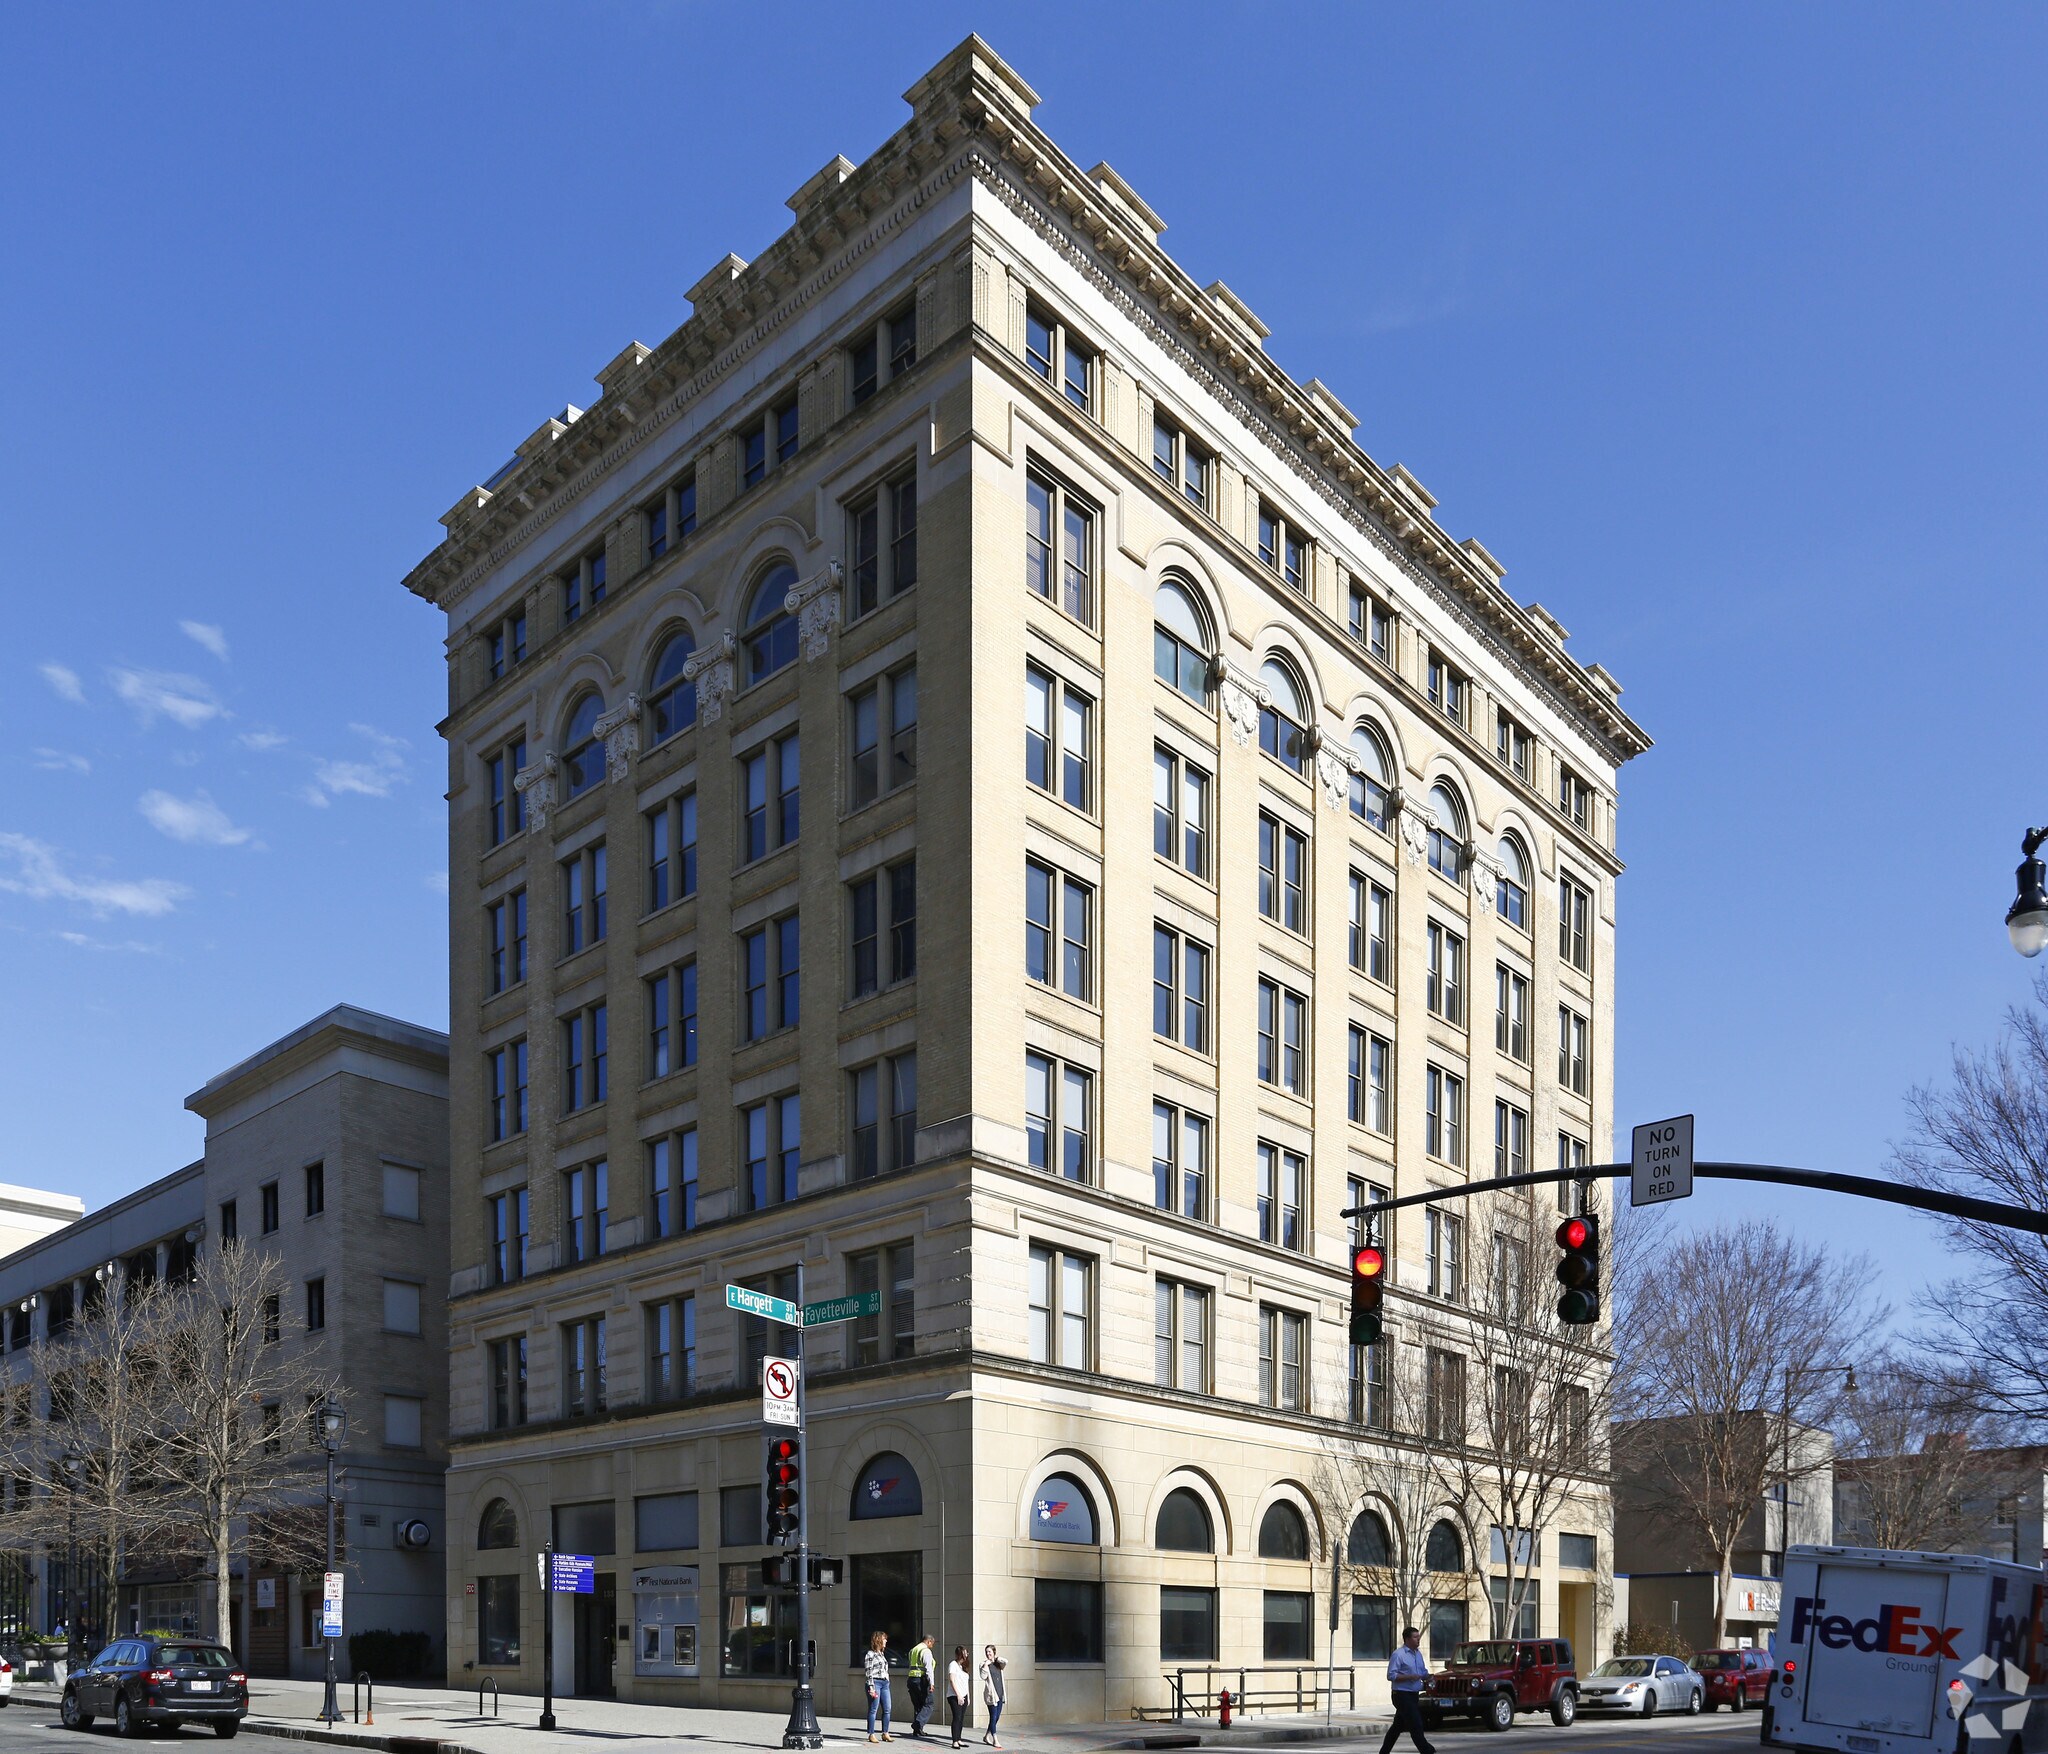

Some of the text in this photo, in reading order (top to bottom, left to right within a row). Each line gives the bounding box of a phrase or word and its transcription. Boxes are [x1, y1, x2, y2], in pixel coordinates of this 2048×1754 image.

[1649, 1126, 1675, 1145] NO
[1645, 1144, 1680, 1163] TURN
[1653, 1164, 1671, 1178] ON
[1649, 1181, 1675, 1196] RED
[731, 1288, 793, 1313] E Hargett ST
[805, 1293, 878, 1323] Fayetteville ST
[868, 1303, 879, 1313] 100
[1048, 1520, 1067, 1529] National
[1068, 1522, 1081, 1530] Bank
[659, 1576, 679, 1586] National
[679, 1576, 692, 1585] Bank
[1790, 1597, 1964, 1660] FedEx
[1886, 1657, 1937, 1675] Ground
